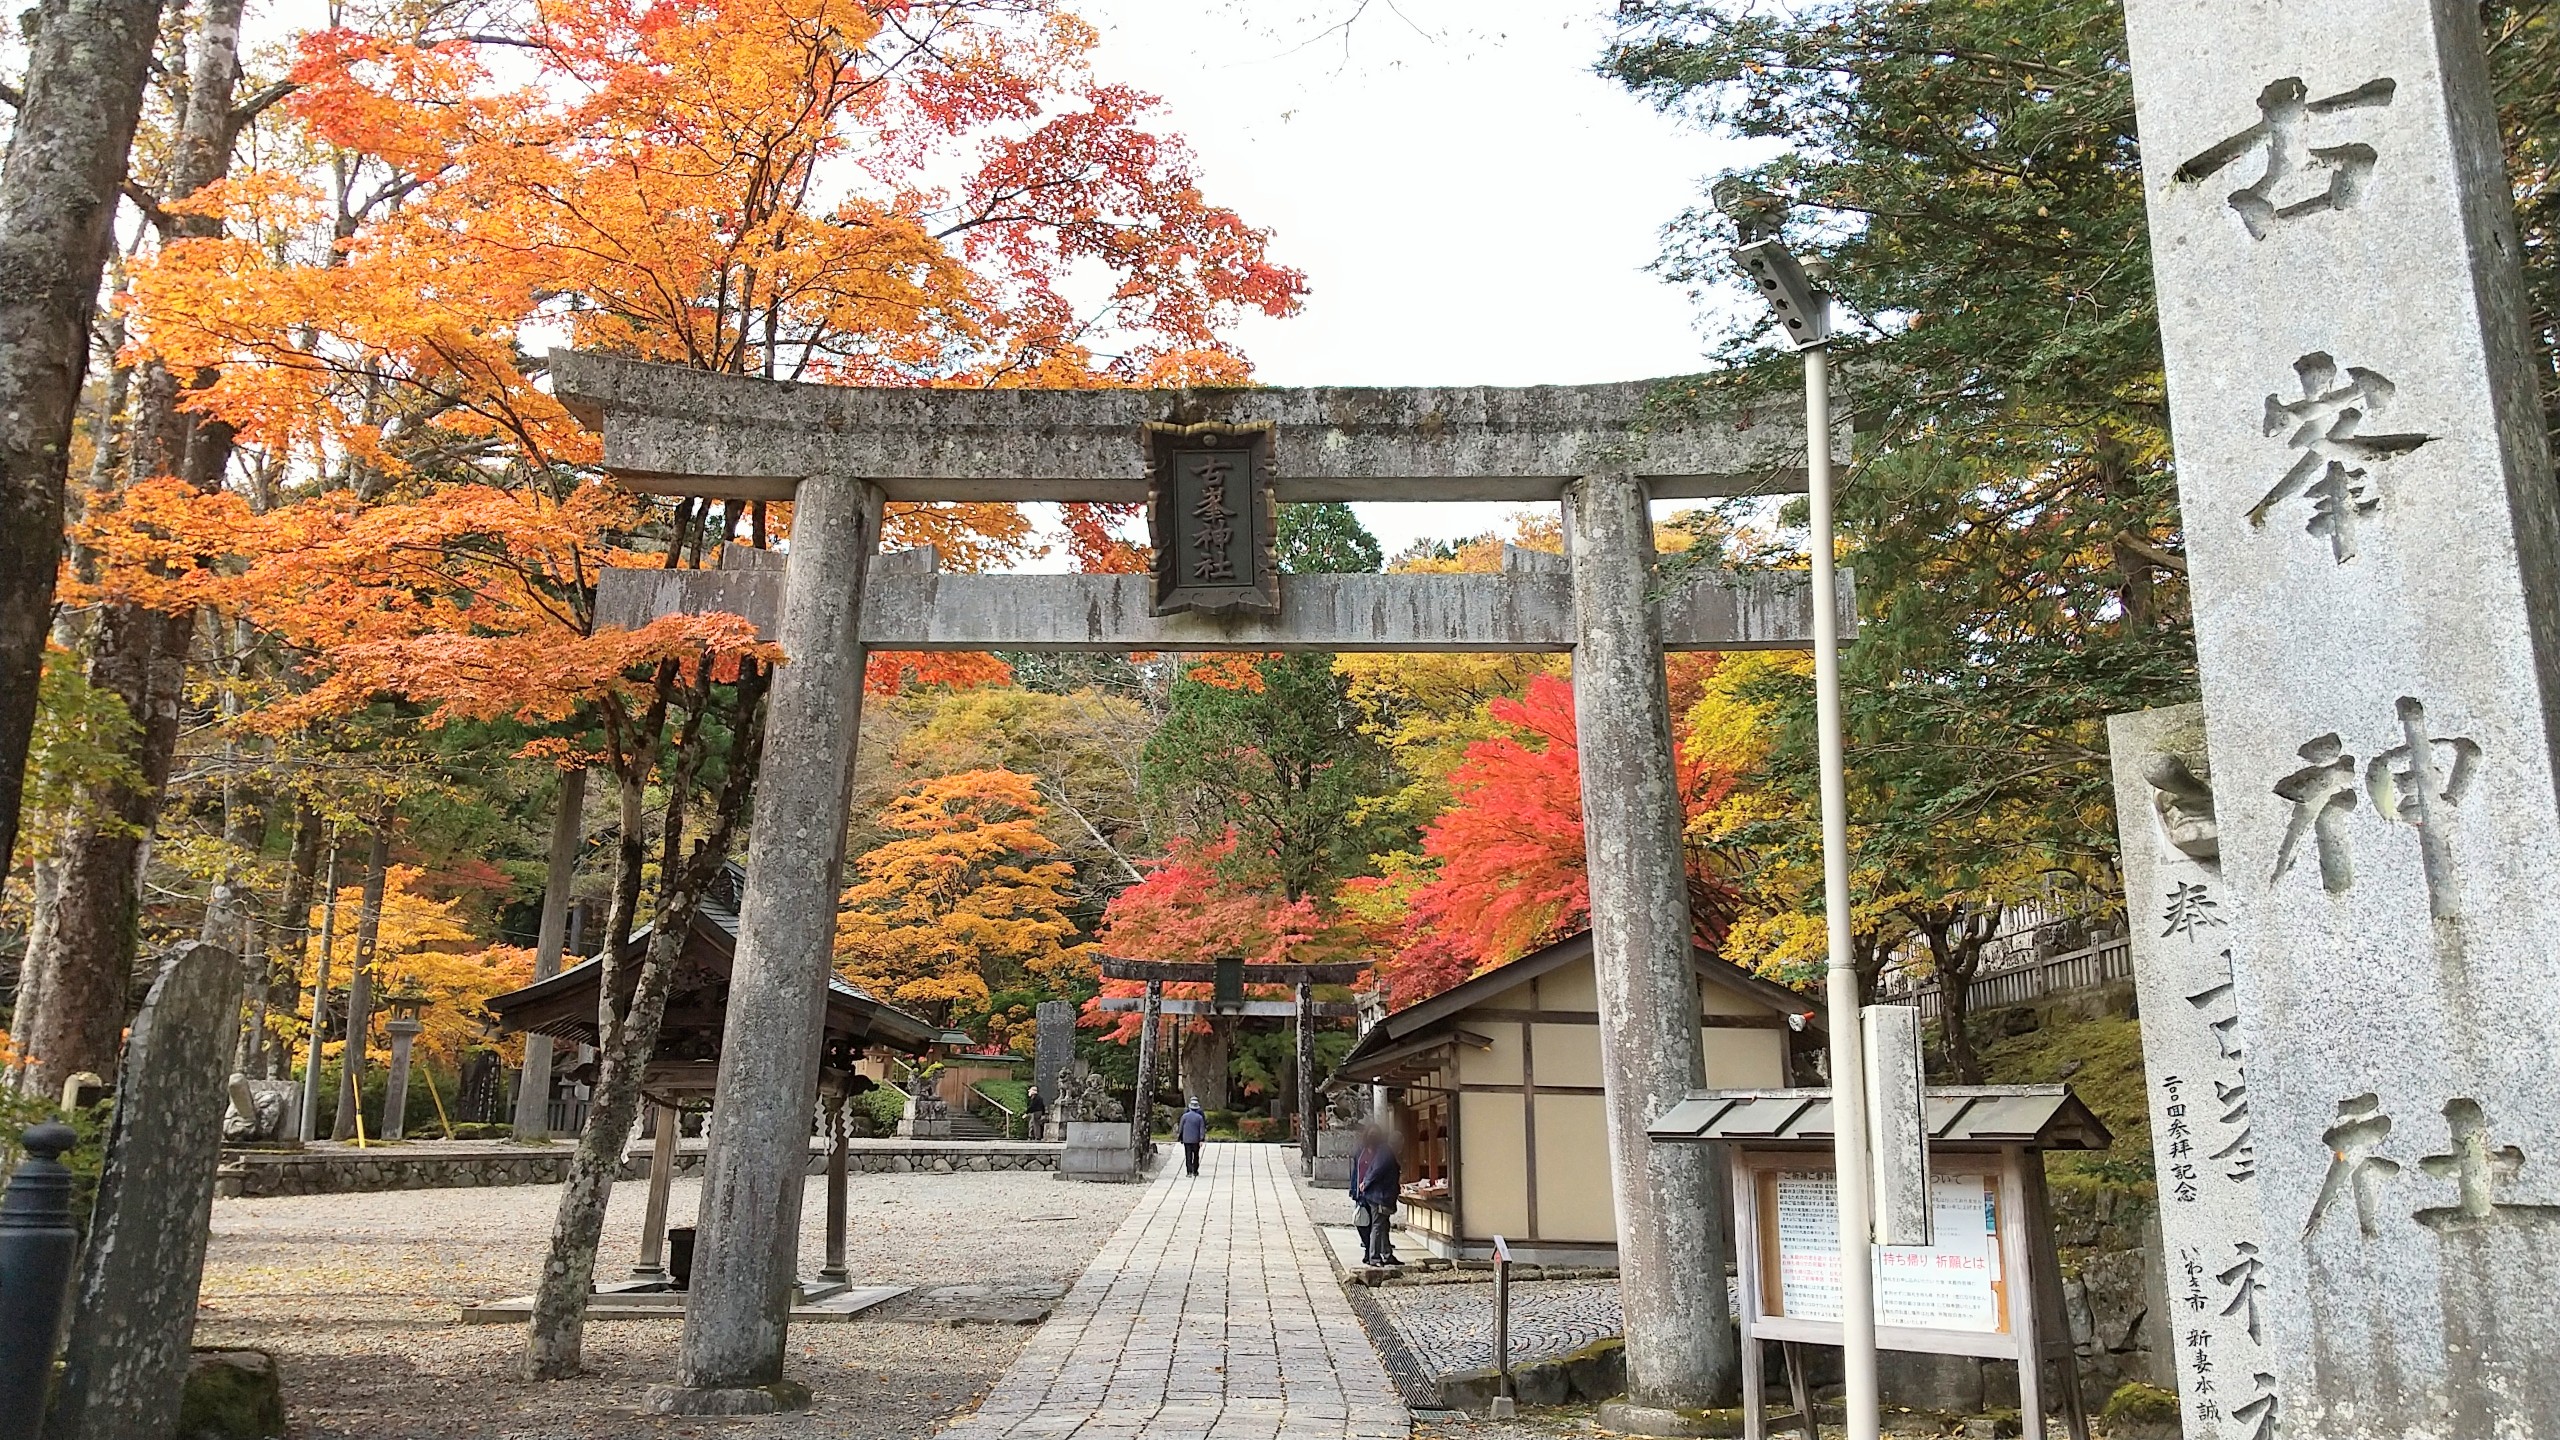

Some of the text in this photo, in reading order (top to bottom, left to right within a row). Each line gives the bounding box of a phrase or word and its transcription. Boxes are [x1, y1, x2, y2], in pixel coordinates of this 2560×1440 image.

[1189, 456, 1238, 583] 古峯神社
[2171, 76, 2560, 1233] 古峯神社
[2160, 881, 2228, 943] 奉
